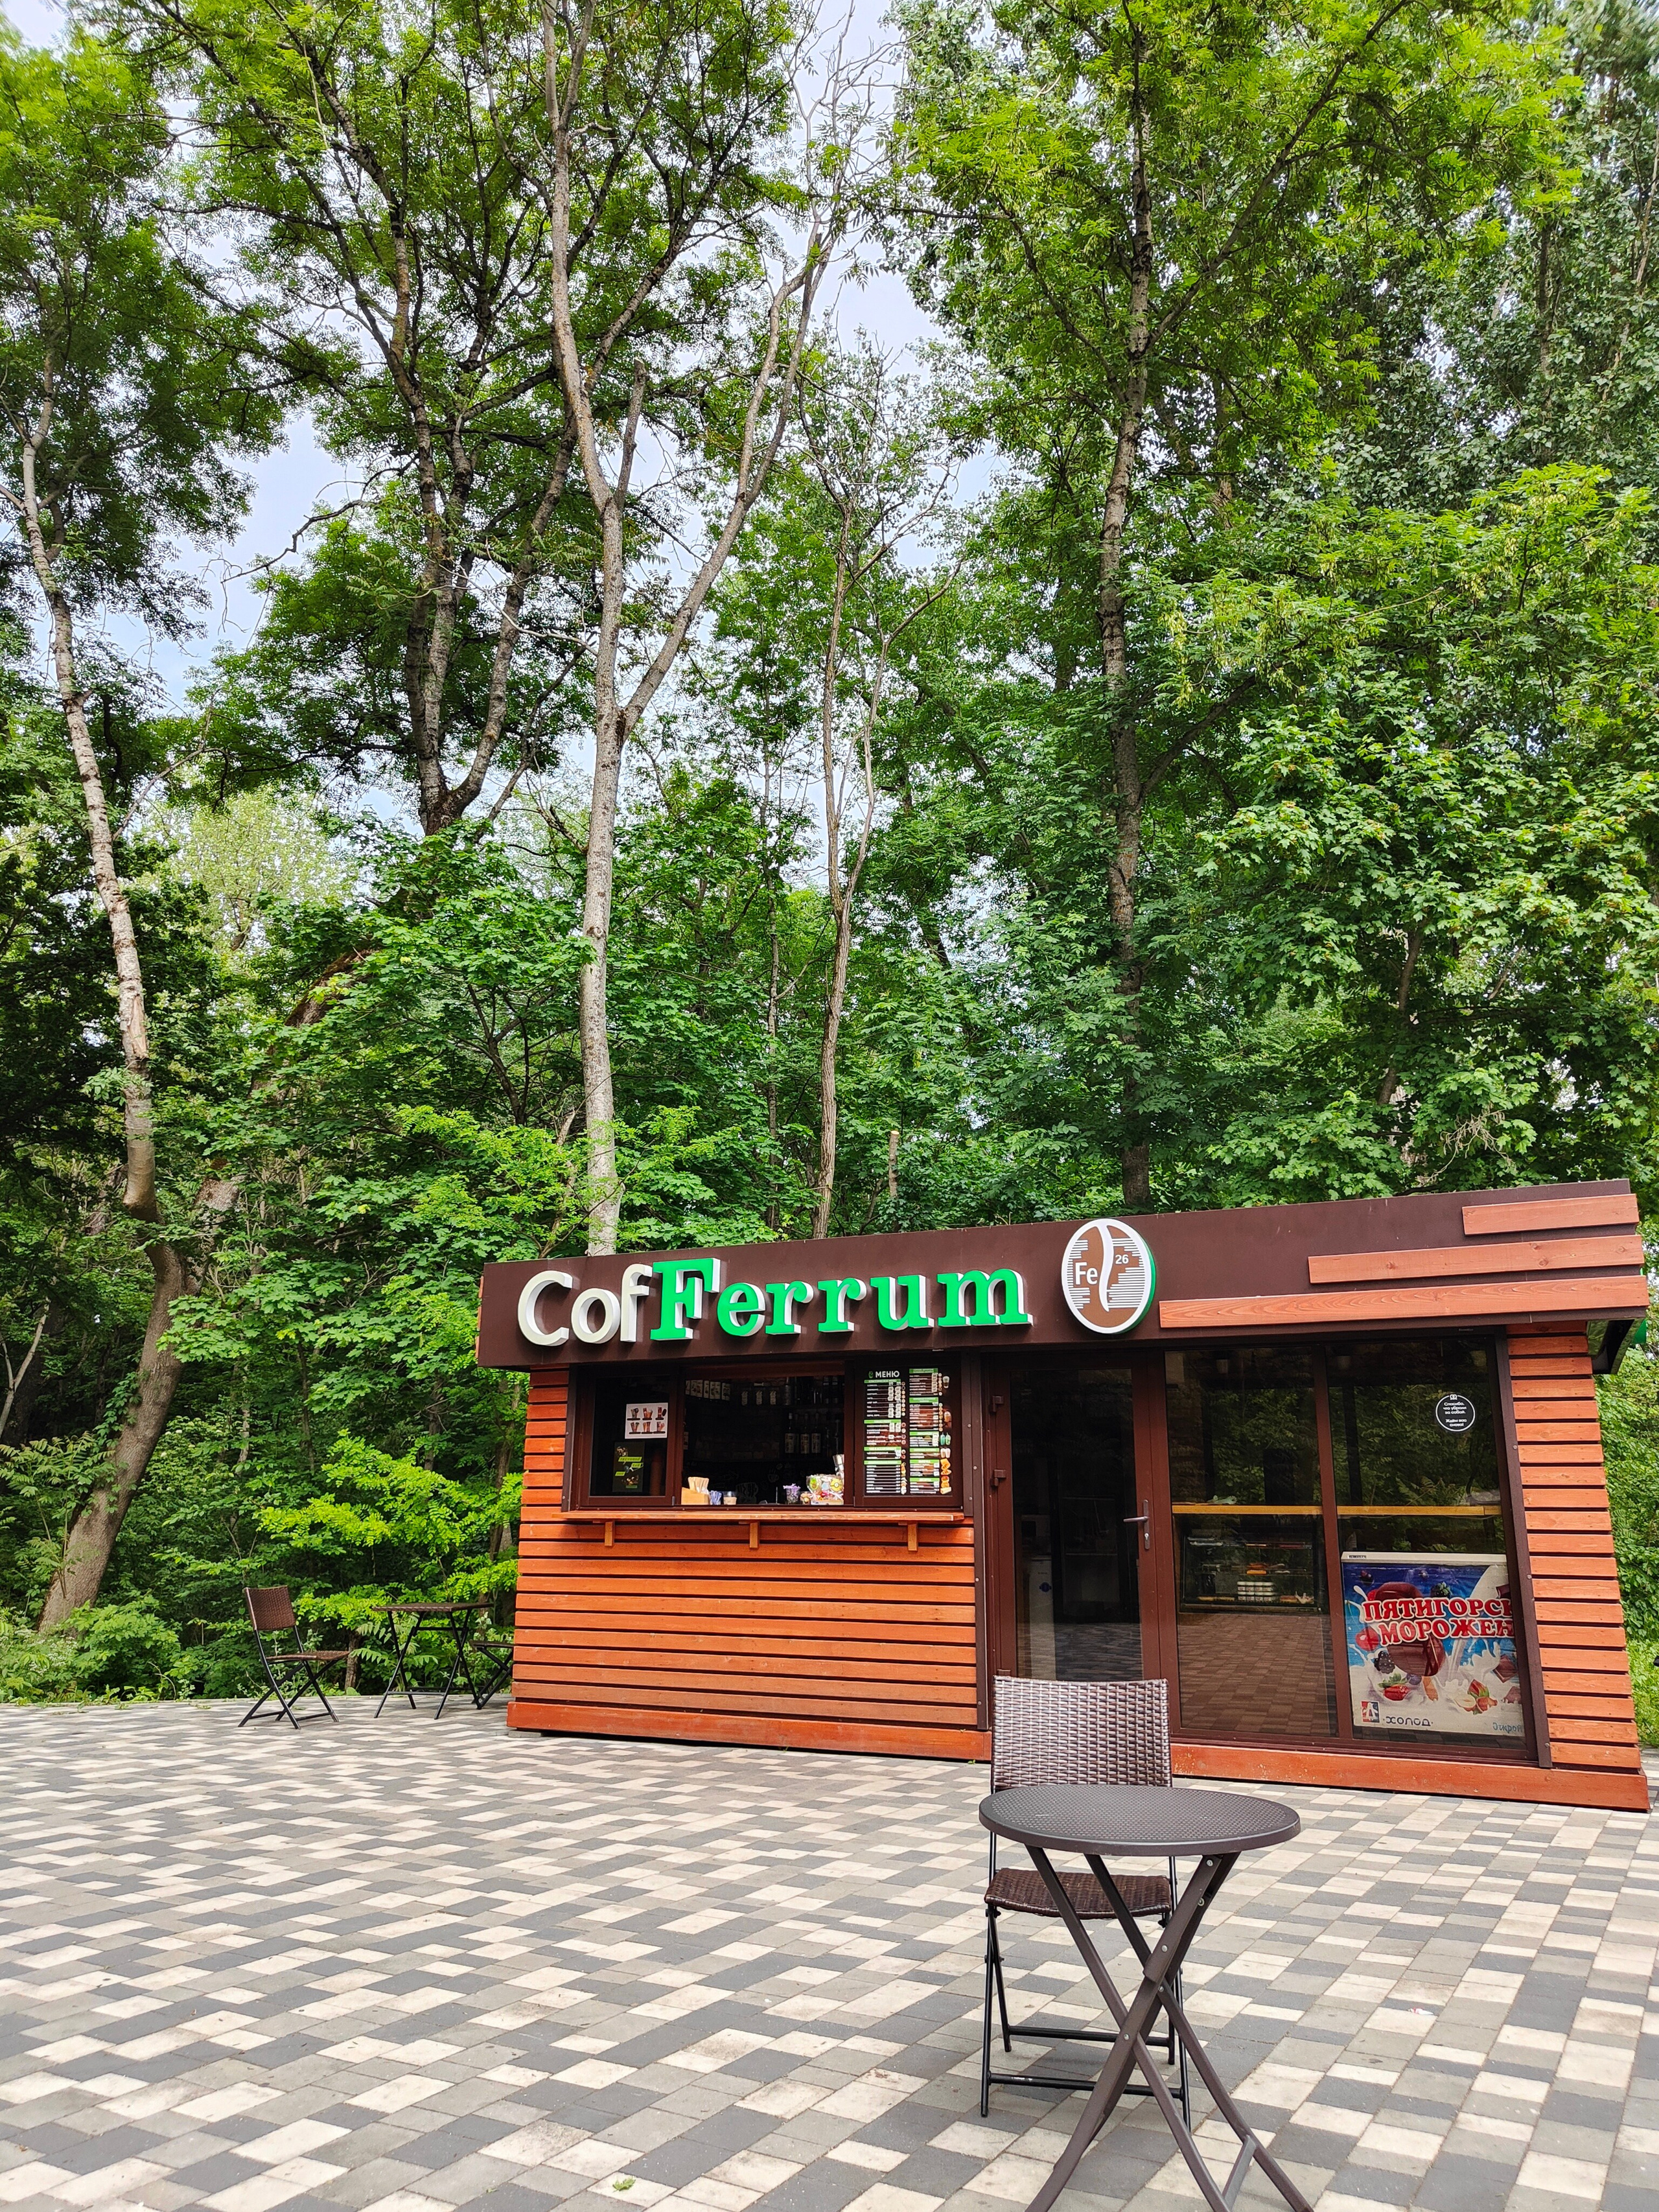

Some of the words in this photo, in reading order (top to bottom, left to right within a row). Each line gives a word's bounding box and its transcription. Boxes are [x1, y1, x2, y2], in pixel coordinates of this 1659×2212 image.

[1115, 1254, 1129, 1264] 26
[1074, 1262, 1098, 1285] Fe
[518, 1257, 1033, 1347] CofFerrum
[1378, 1618, 1515, 1646] МОРОЖЕН
